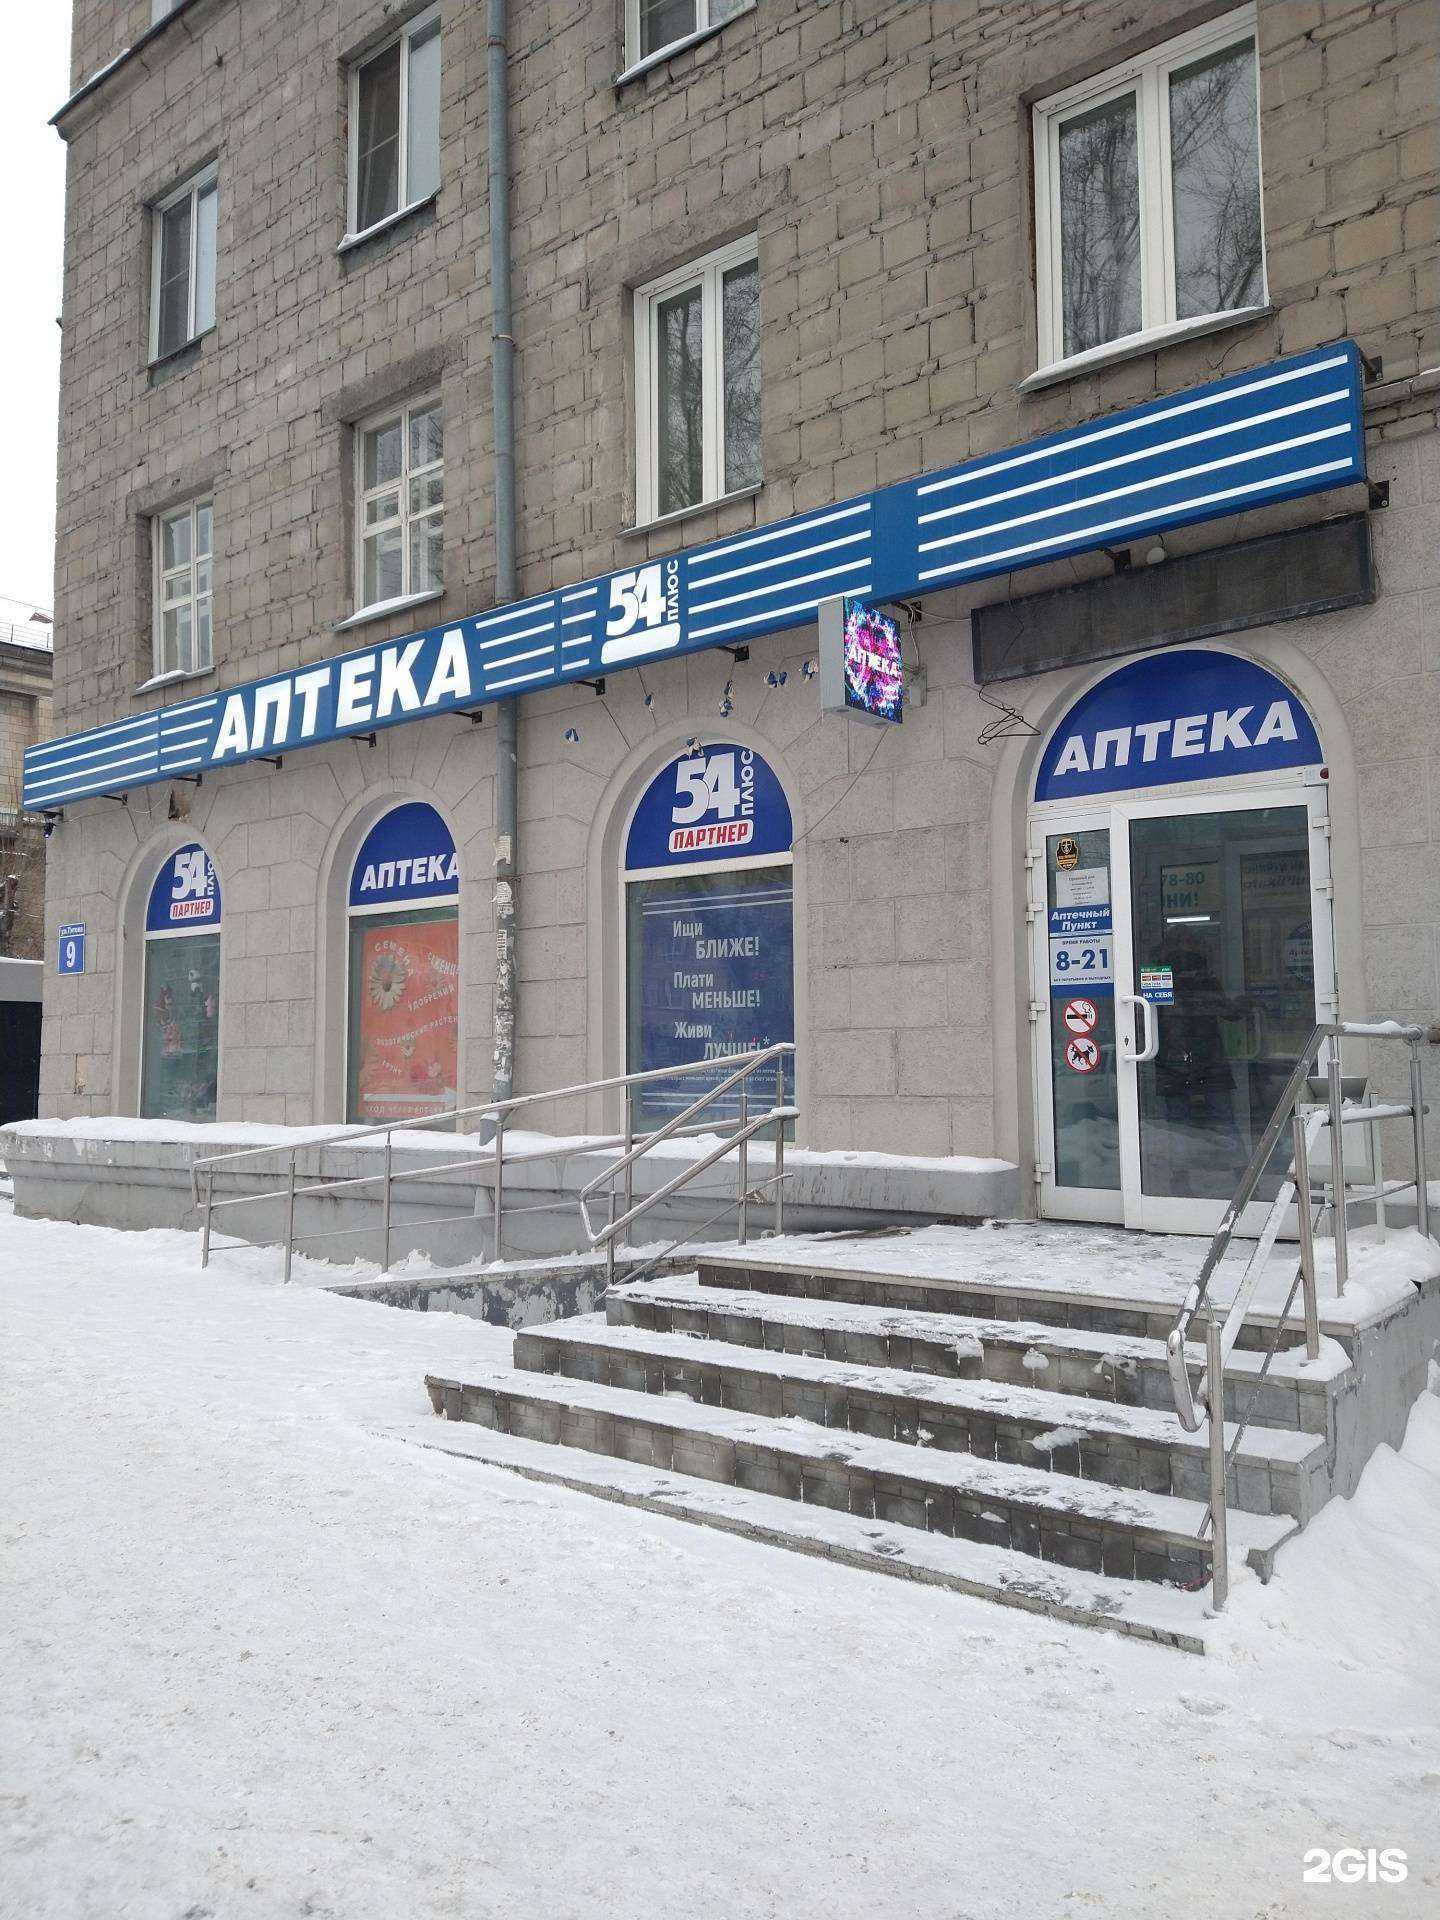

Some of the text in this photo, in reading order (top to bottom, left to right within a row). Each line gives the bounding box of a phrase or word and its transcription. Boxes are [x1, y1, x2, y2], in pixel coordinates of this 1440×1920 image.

[606, 564, 666, 636] 54
[667, 560, 679, 621] ПЛЮС
[847, 643, 899, 678] АПТЕКА
[211, 628, 471, 759] АПТЕКА
[1053, 700, 1298, 776] АПТЕКА
[672, 752, 740, 823] 54
[741, 750, 754, 815] ПЛЮС
[673, 823, 749, 849] ПАРТНЕР
[172, 851, 207, 899] 54
[360, 852, 460, 891] АПТЕКА
[173, 901, 211, 917] ПАРТНЕР
[1051, 907, 1110, 920] Аптечный
[673, 920, 703, 938] Ищи
[1062, 921, 1098, 932] Пункт
[66, 941, 75, 967] 9
[695, 936, 759, 960] БЛИЖЕ!
[1056, 948, 1108, 971] 8-21
[673, 971, 714, 989] Плати
[692, 989, 761, 1009] МЕНЬШЕ!
[674, 1021, 712, 1039] Живи
